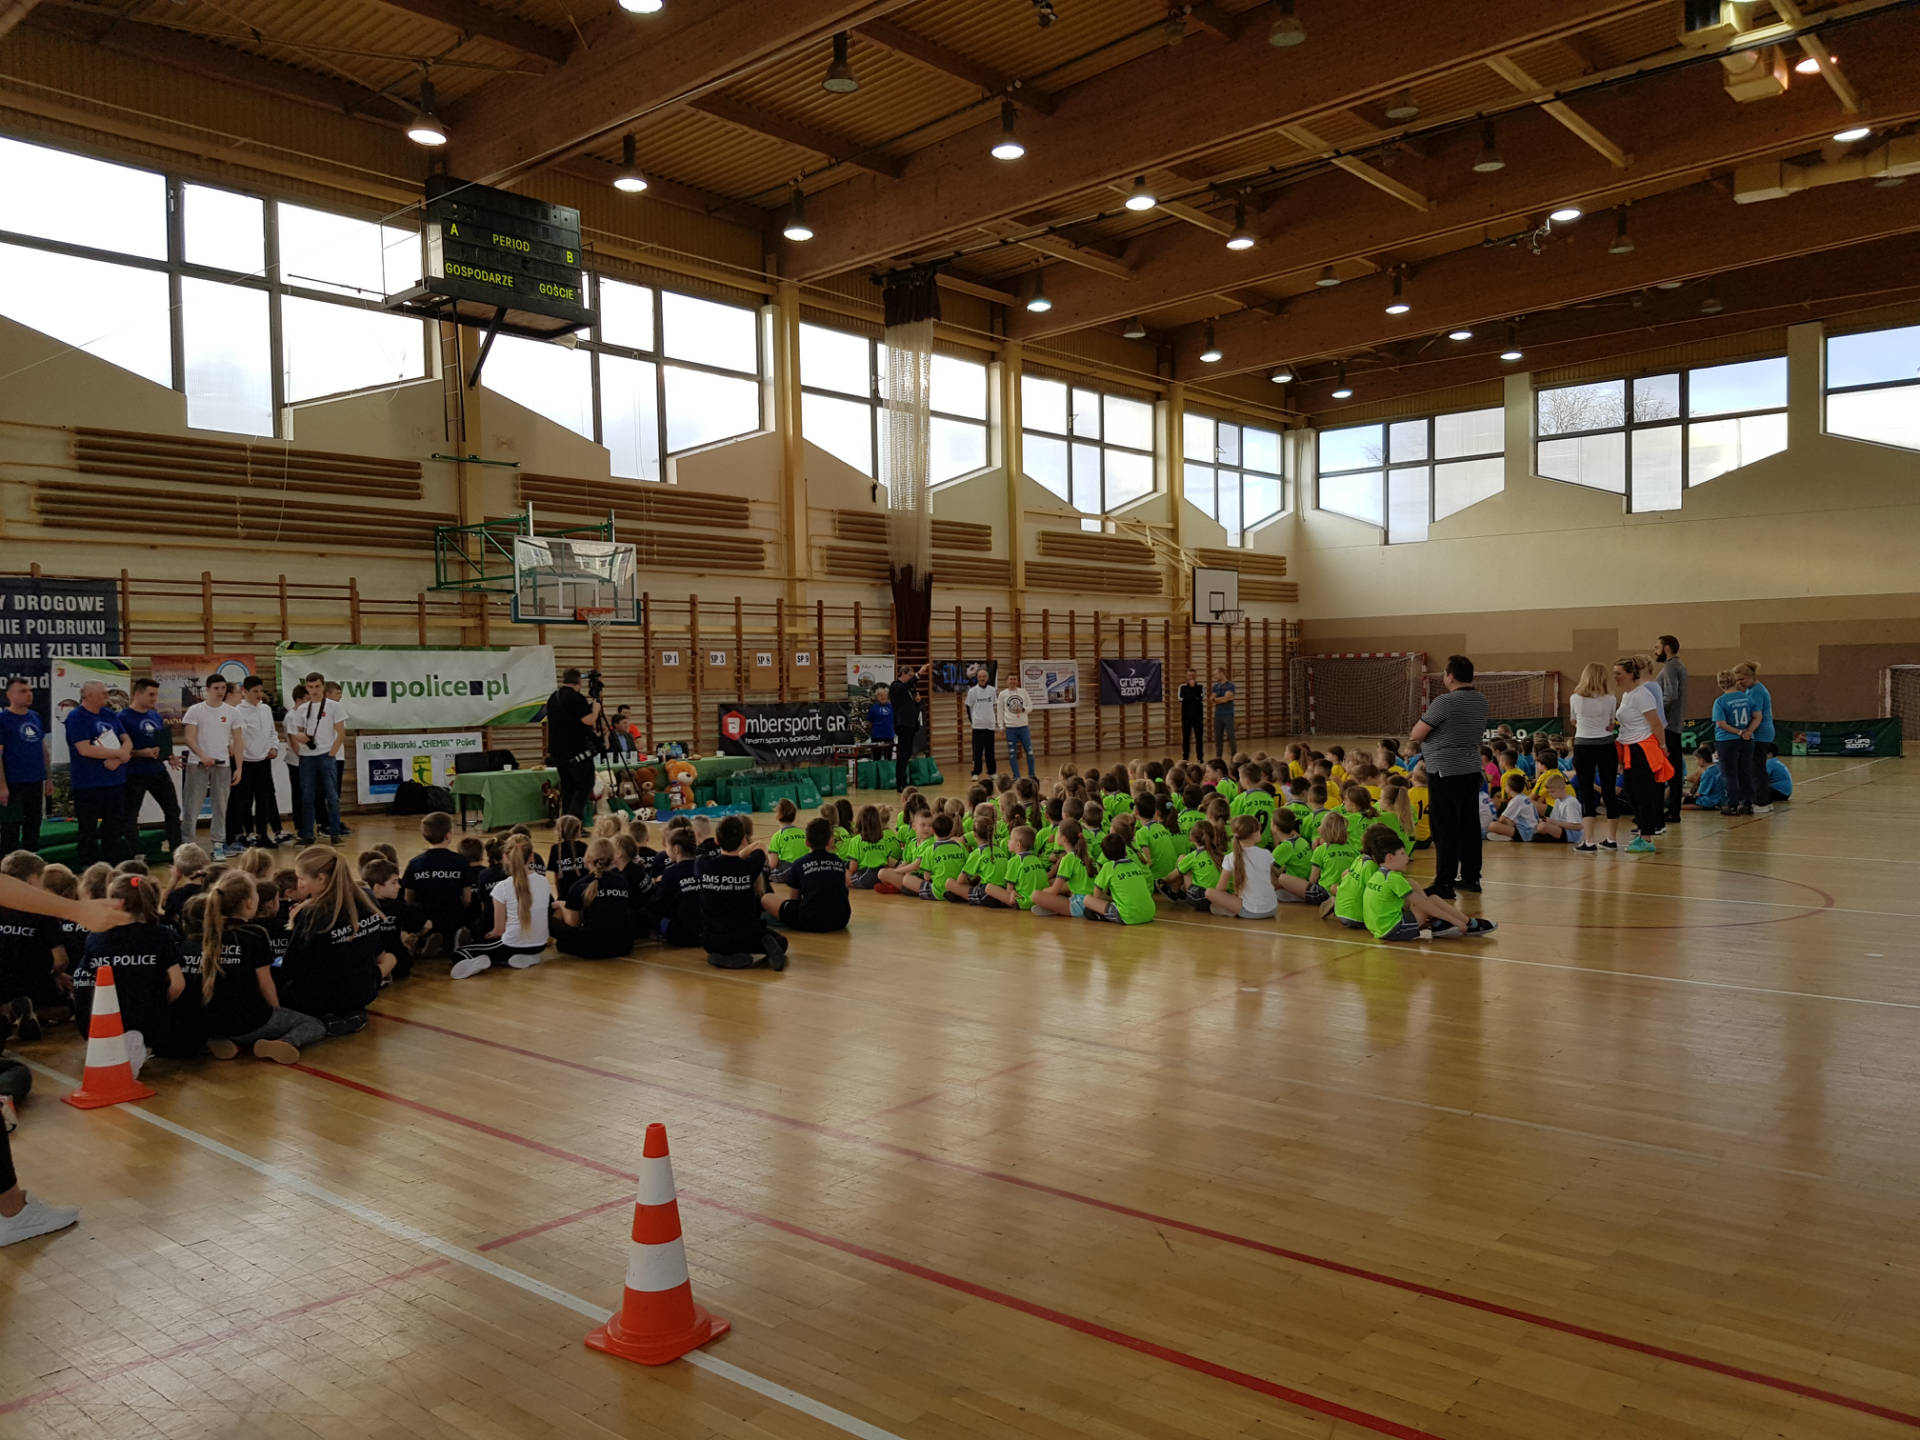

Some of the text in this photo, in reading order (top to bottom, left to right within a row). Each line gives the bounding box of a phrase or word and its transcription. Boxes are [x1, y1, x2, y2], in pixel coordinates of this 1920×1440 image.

[450, 223, 459, 237] A
[492, 233, 531, 253] PERIOD
[566, 251, 575, 264] B
[445, 262, 514, 288] GOSPODARZE
[539, 282, 575, 300] GOŚCIE
[14, 595, 105, 611] DROGOWE
[25, 619, 106, 635] POLBRUKU
[0, 643, 107, 659] ANIE ZIELENI
[664, 654, 672, 664] SP
[711, 654, 719, 664] SP
[797, 655, 804, 663] SP
[1733, 707, 1749, 728] 14
[701, 873, 752, 885] SMS POLICE
[330, 924, 352, 938] SMS
[113, 954, 158, 967] POLICE
